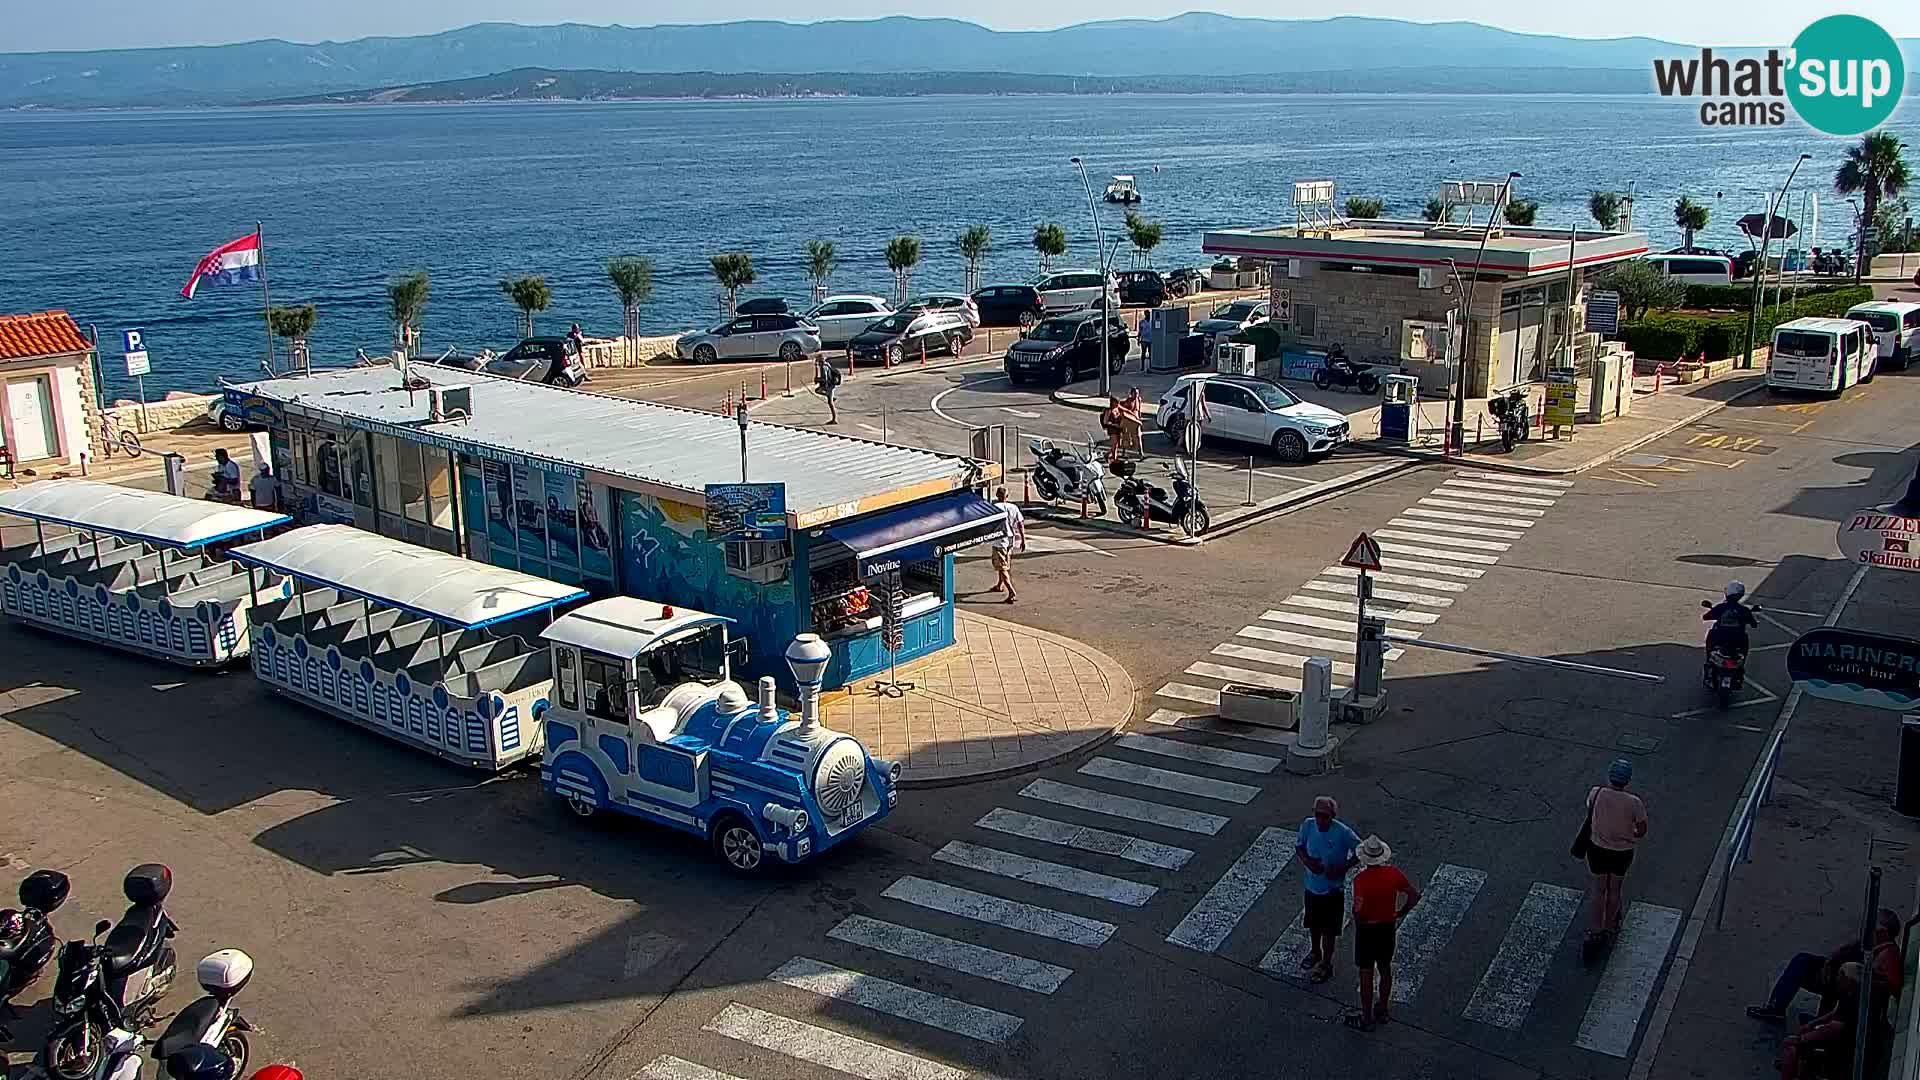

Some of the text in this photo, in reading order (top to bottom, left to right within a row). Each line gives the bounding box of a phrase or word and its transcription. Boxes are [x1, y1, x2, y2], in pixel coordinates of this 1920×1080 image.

[127, 331, 141, 350] P
[1685, 433, 1764, 451] TAXI
[435, 437, 466, 453] POSTAJA
[477, 447, 491, 458] BUS
[493, 451, 524, 466] STATION
[527, 457, 552, 472] TICKET
[554, 463, 582, 478] OFFICE
[1848, 515, 1920, 534] PIZZE
[1881, 530, 1916, 541] GRILL
[1870, 665, 1897, 681] bar
